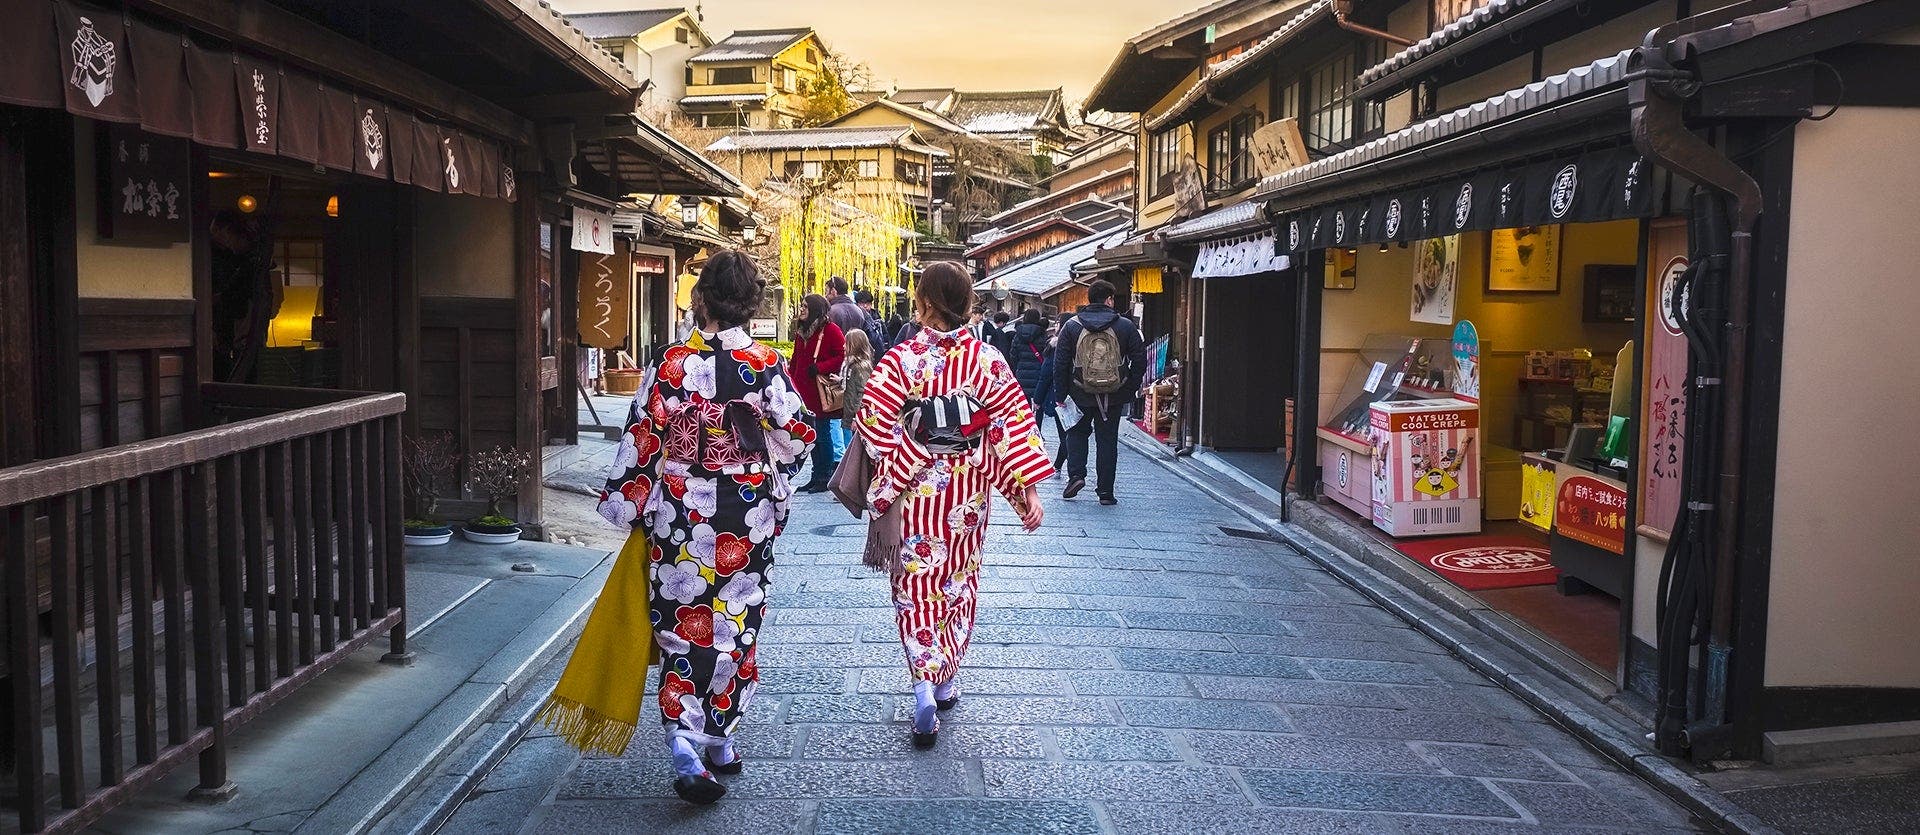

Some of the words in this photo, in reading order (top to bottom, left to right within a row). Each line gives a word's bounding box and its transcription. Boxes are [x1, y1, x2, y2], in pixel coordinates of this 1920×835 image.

[594, 254, 613, 339] くろちく
[1409, 413, 1459, 423] YATSUZO
[1401, 422, 1429, 430] COOL
[1432, 419, 1467, 428] CREPE
